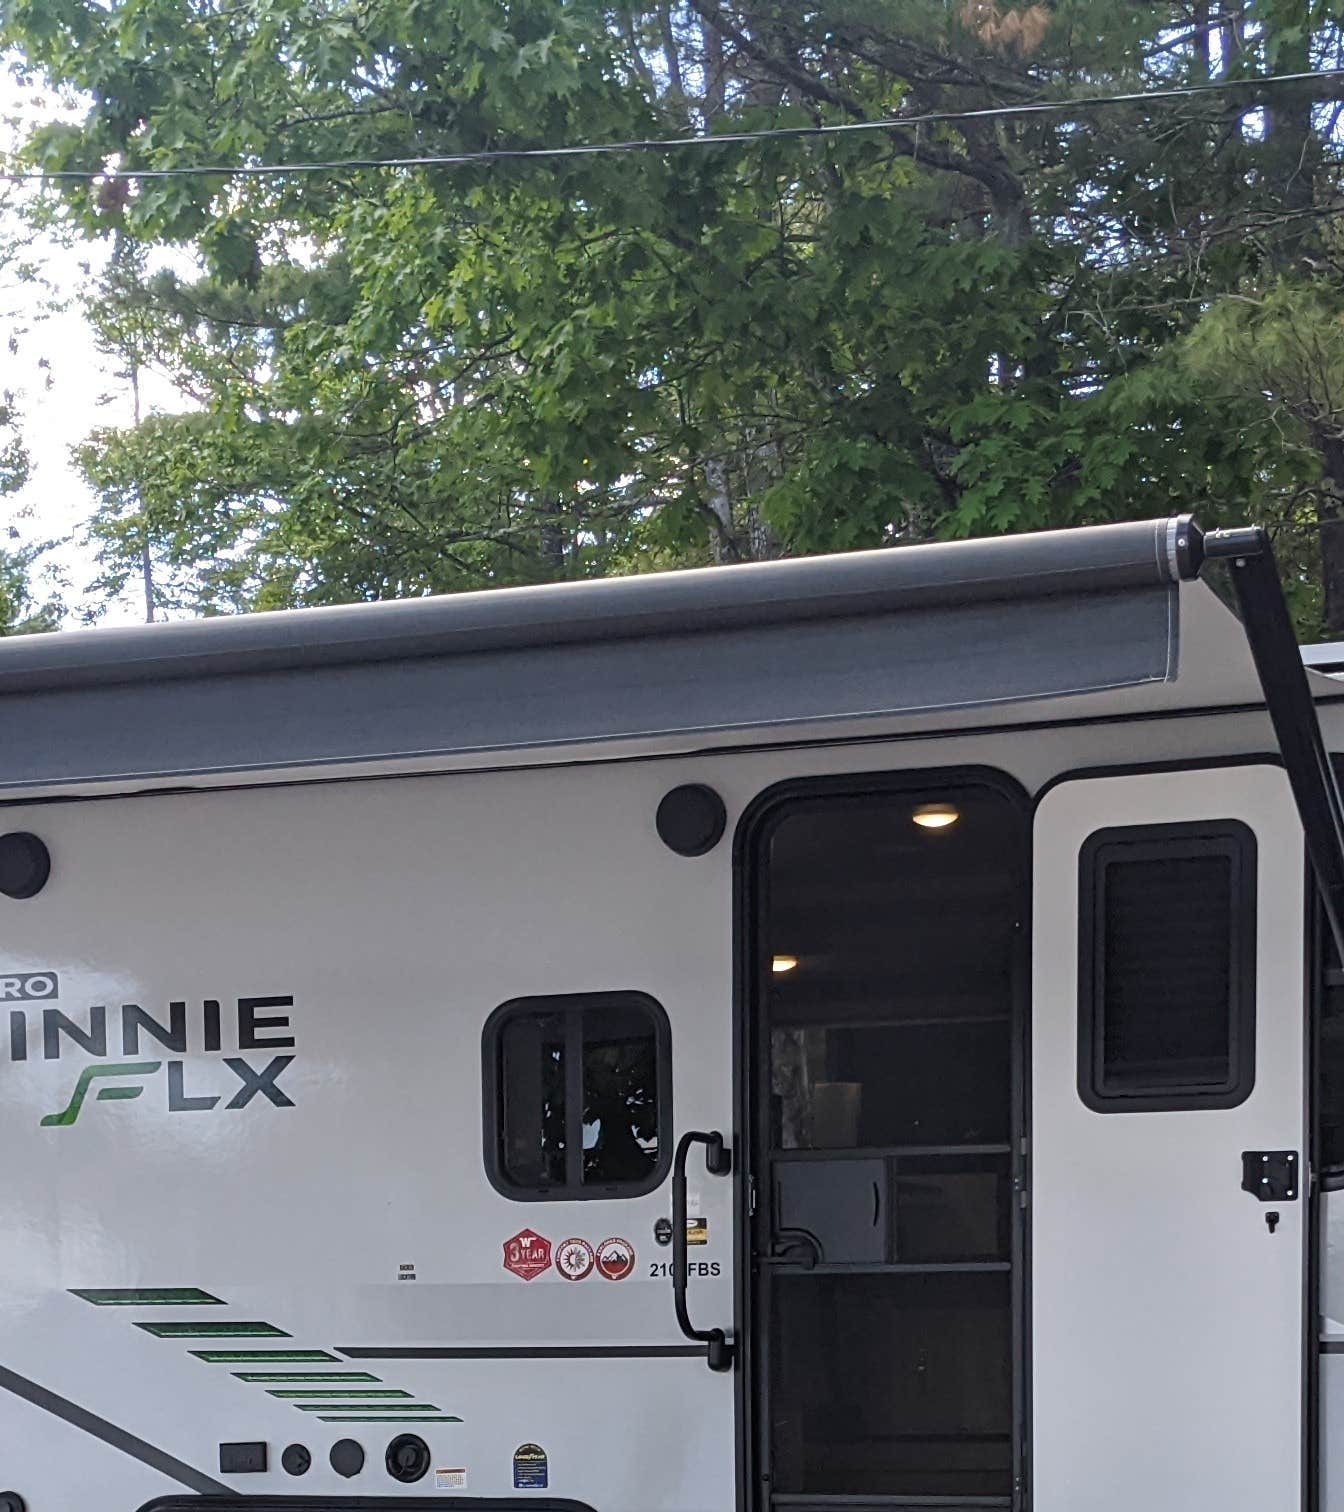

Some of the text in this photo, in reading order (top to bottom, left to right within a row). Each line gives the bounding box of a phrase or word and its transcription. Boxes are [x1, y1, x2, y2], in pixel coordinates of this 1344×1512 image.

[40, 1055, 296, 1126] FLX
[509, 1243, 520, 1262] 3
[520, 1248, 545, 1260] YEAR
[650, 1262, 721, 1277] 210FBS
